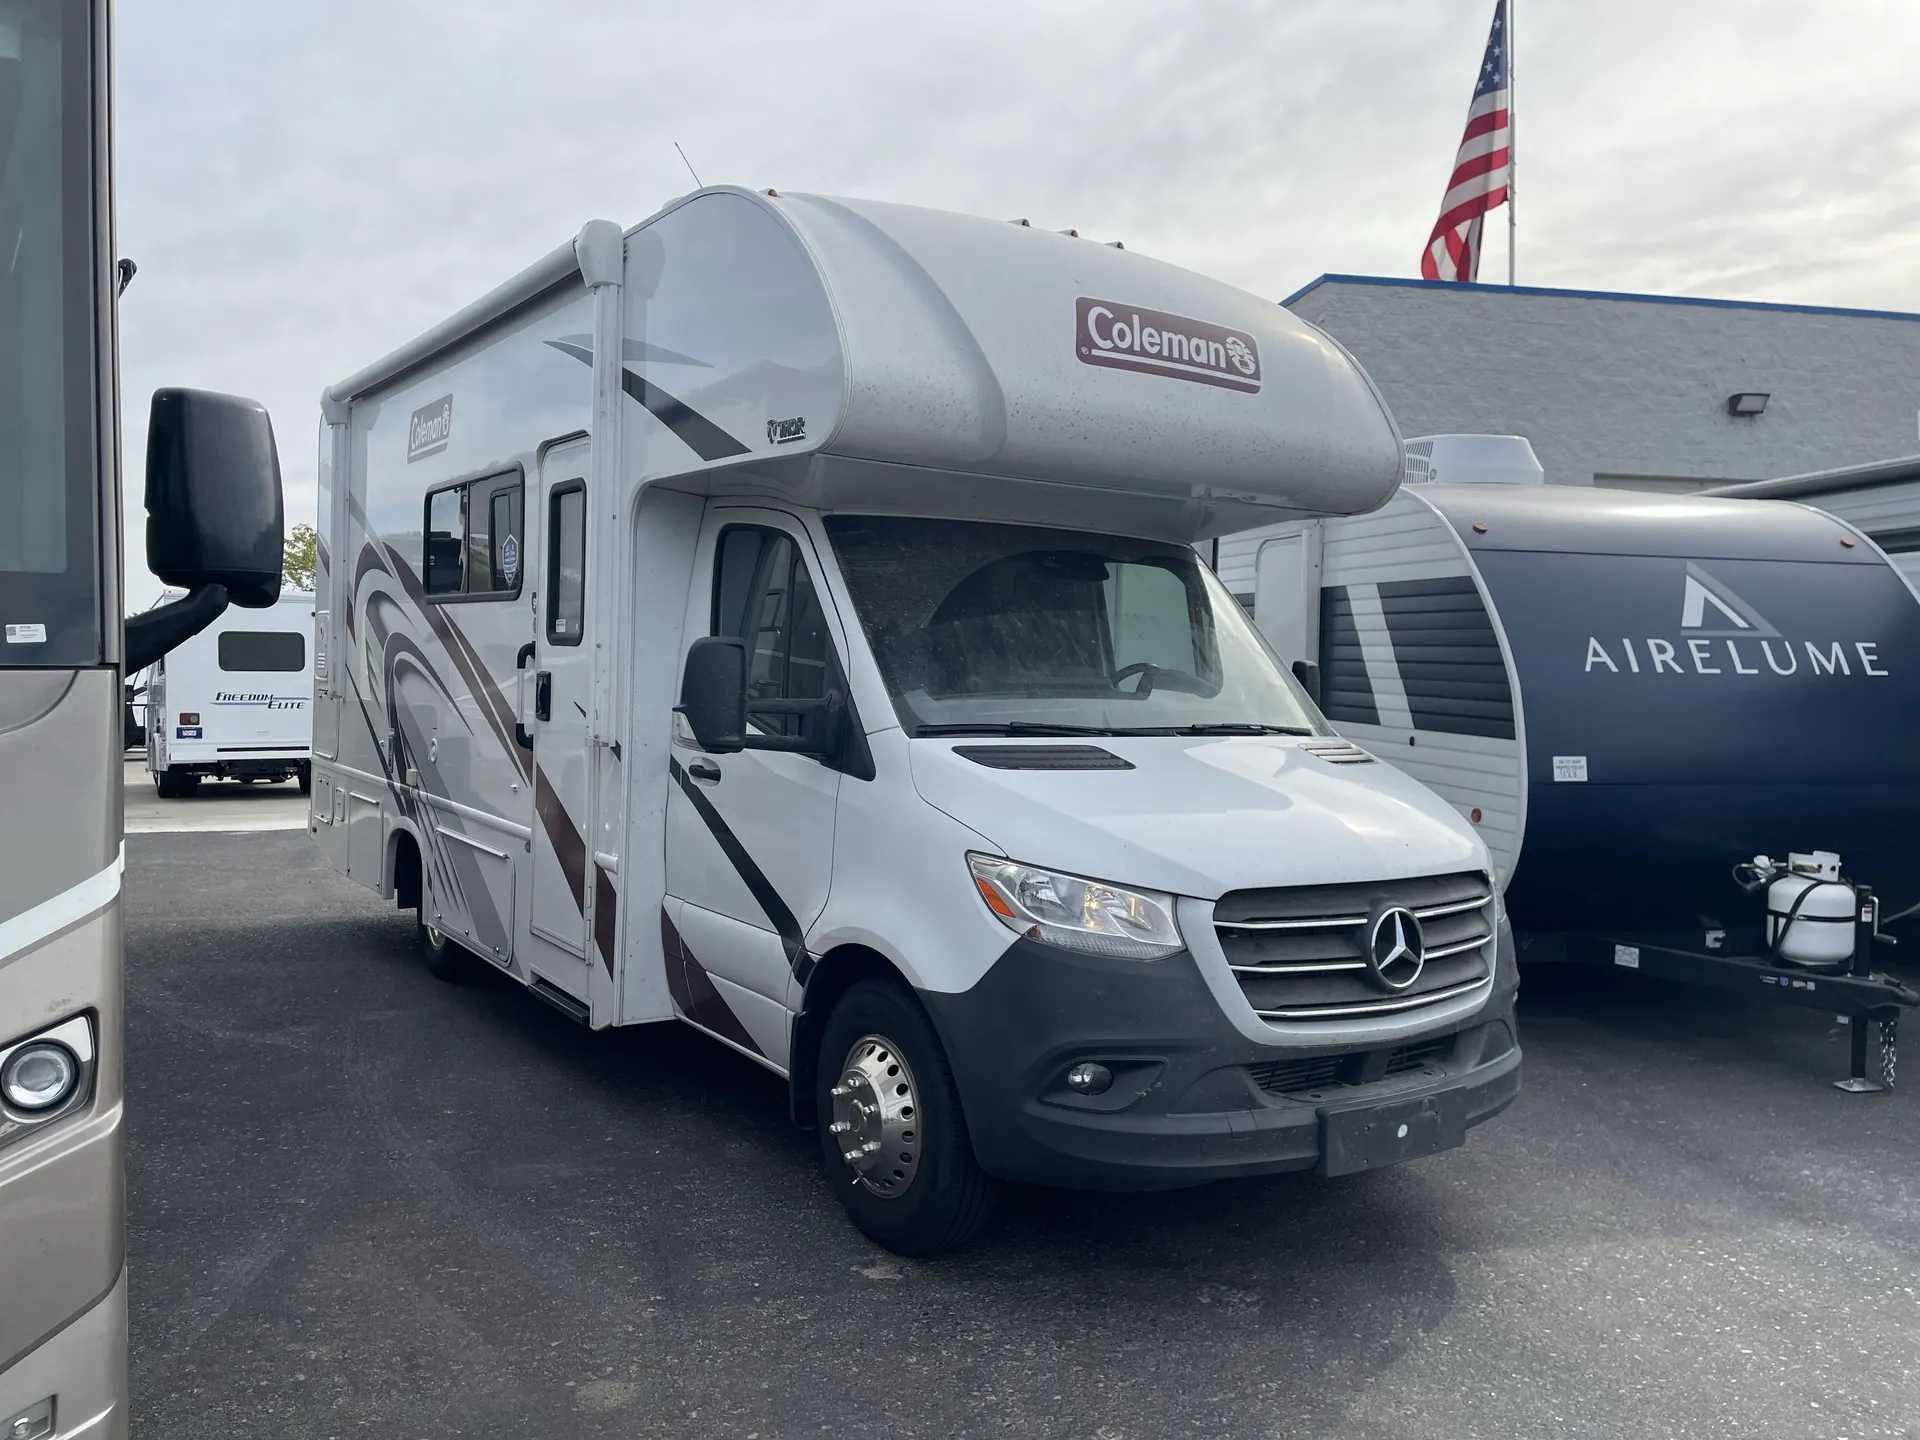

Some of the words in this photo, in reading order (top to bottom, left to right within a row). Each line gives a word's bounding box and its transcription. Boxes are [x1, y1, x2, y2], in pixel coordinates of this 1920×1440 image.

[1087, 306, 1227, 369] Coleman
[411, 414, 442, 450] Coleman
[1585, 636, 1889, 676] AIRELUME
[215, 692, 274, 701] FREEDOM
[267, 700, 305, 710] ELITE
